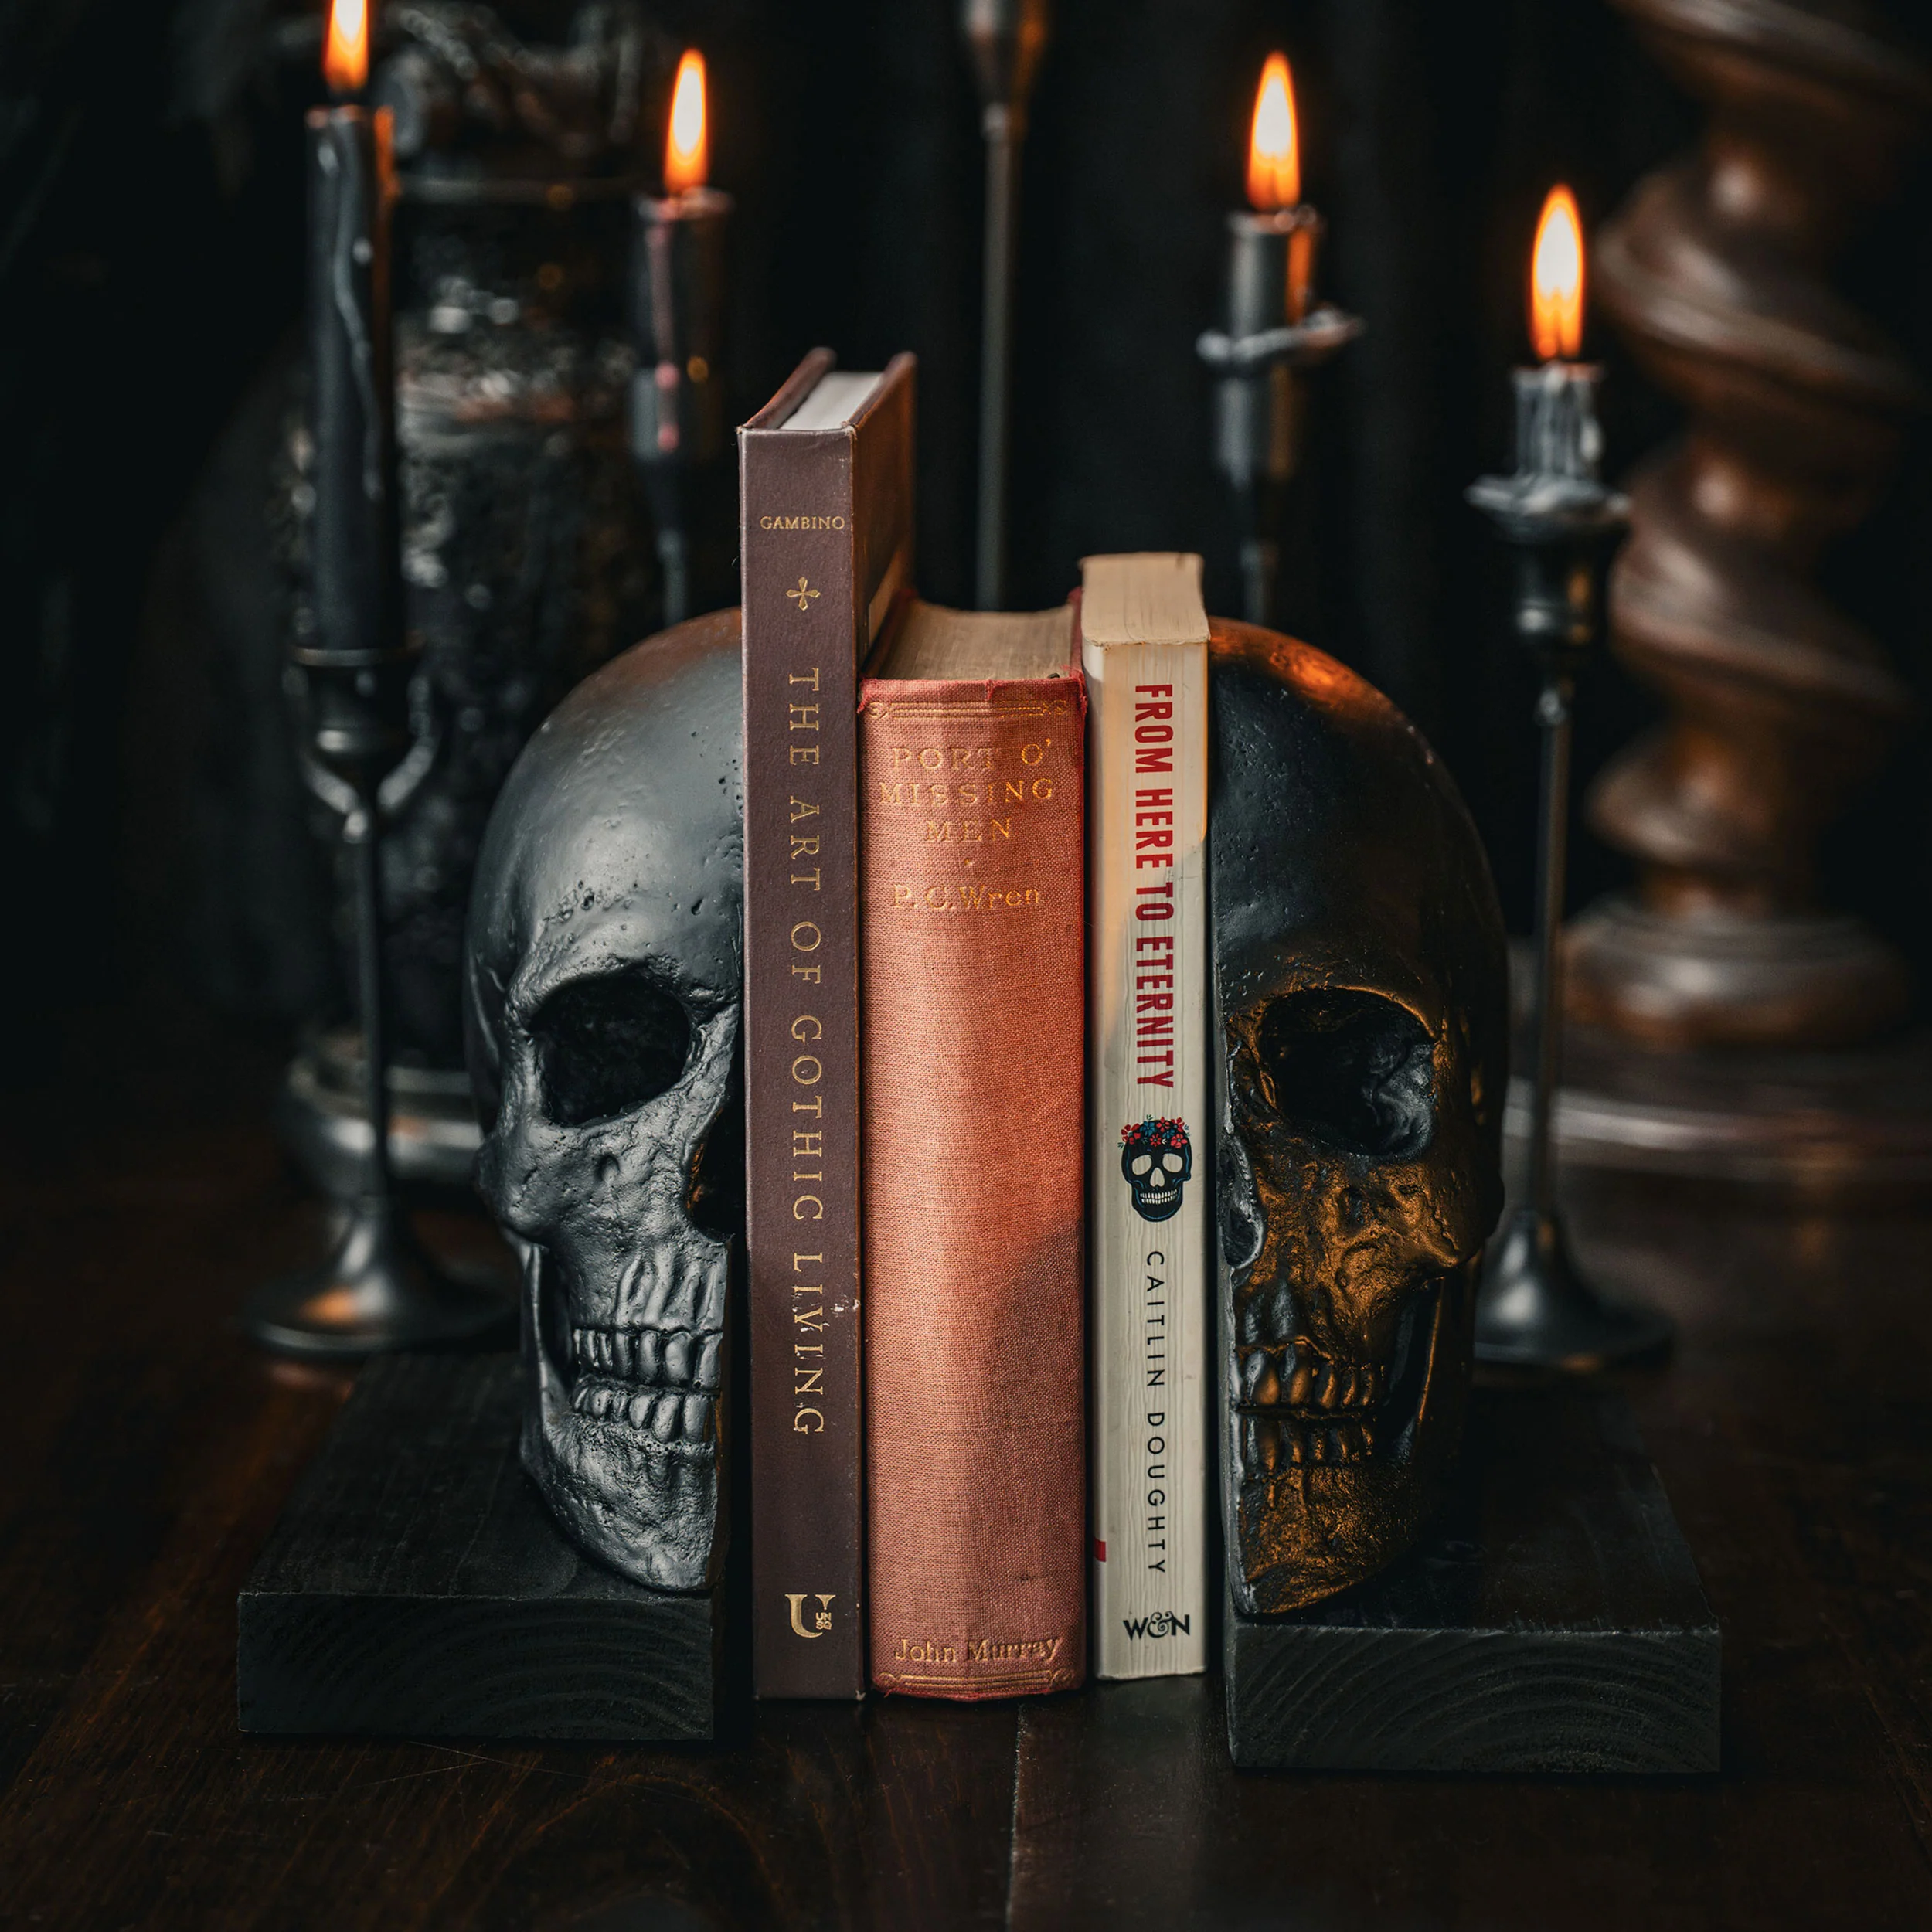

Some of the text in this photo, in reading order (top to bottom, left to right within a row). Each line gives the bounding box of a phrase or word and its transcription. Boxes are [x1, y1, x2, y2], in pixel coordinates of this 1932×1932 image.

[760, 515, 845, 529] GAMBINO
[891, 737, 1052, 771] PORT O'
[879, 777, 1053, 806] MISSING
[926, 816, 1012, 842] MEN
[1134, 683, 1175, 1089] FROM HERE TO ETERNITY
[788, 667, 825, 1435] THE ART OF GOTHIC LIVING
[1146, 1250, 1165, 1573] CAITLIN DOUGHTY
[1123, 1611, 1190, 1641] W&N
[895, 1636, 1063, 1662] John Murray
